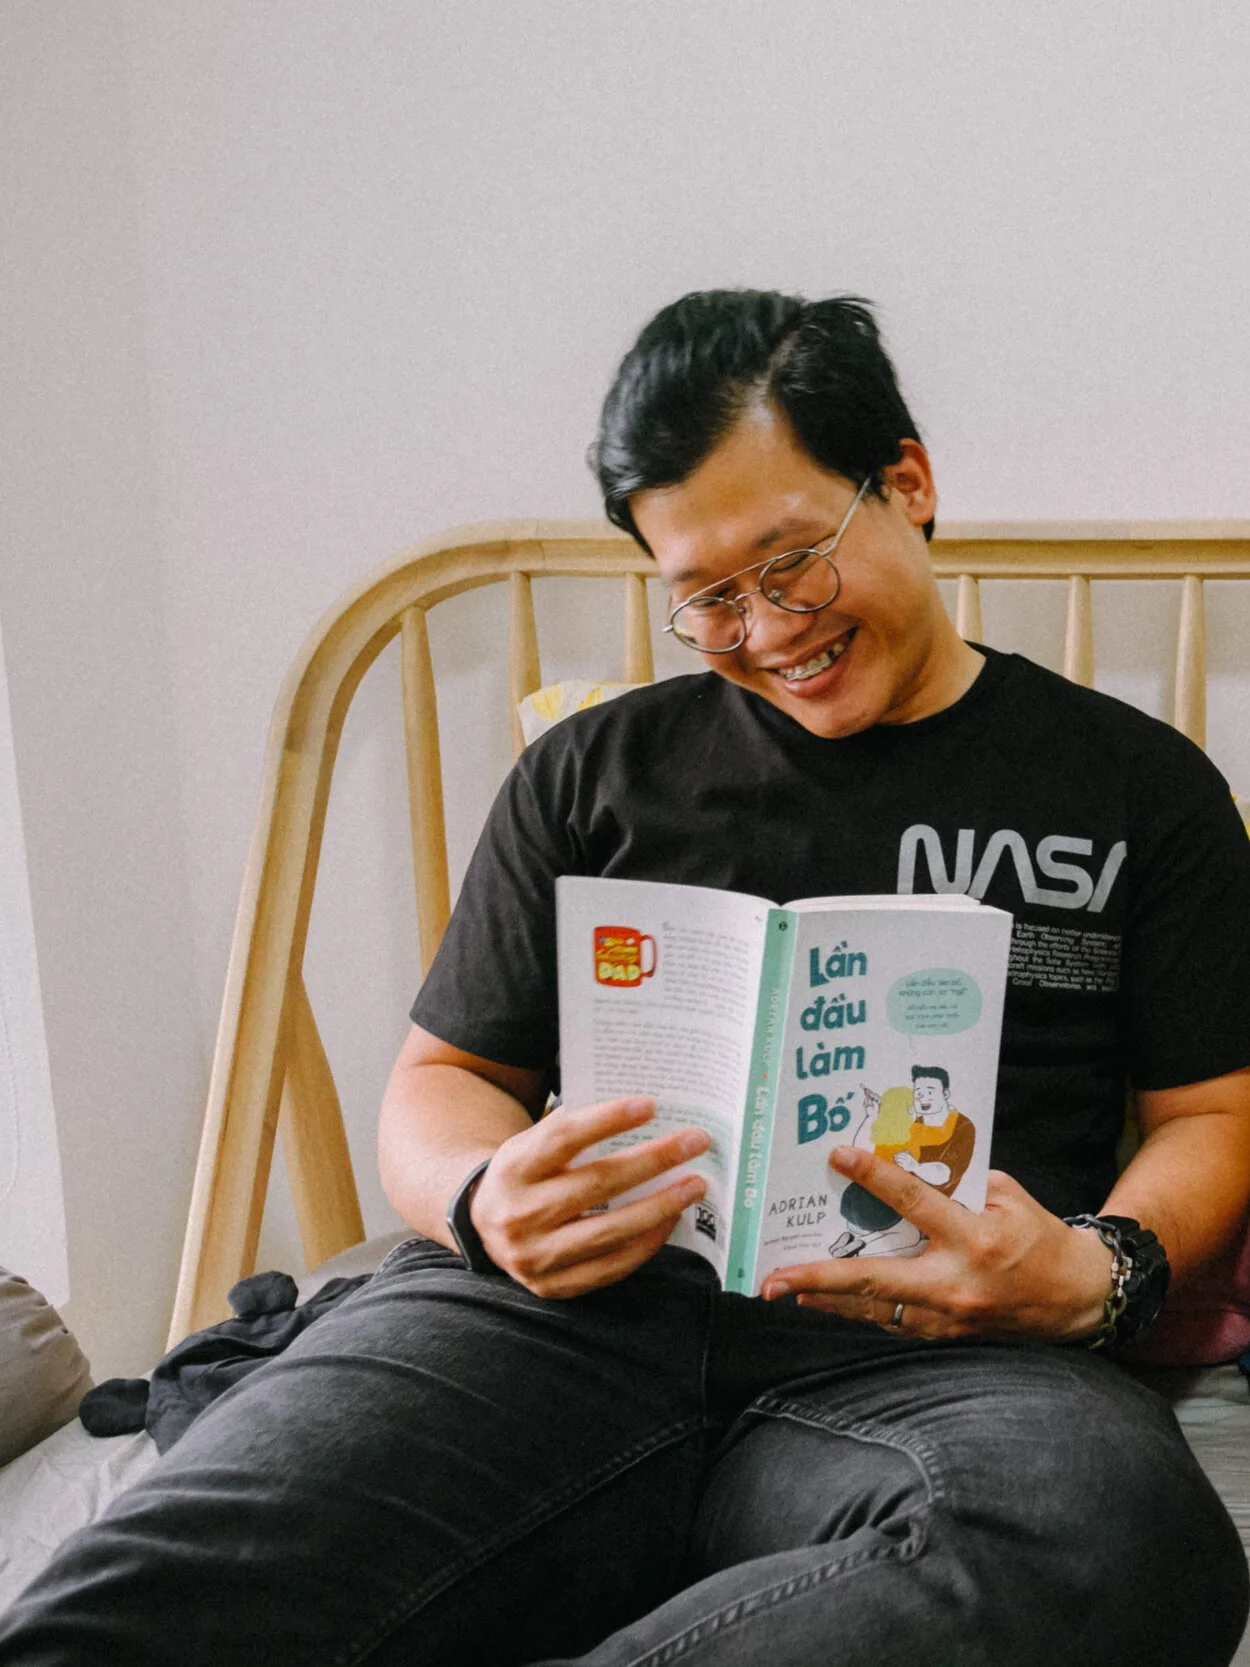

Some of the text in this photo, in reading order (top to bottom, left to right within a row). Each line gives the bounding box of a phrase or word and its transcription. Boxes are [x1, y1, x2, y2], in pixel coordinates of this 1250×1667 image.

[598, 961, 641, 981] DAD
[809, 941, 868, 988] Lần
[800, 993, 867, 1032] đầu
[796, 1042, 865, 1080] làm
[798, 1091, 855, 1145] Bố
[768, 1193, 828, 1217] ADRIAN
[786, 1211, 826, 1228] KULP
